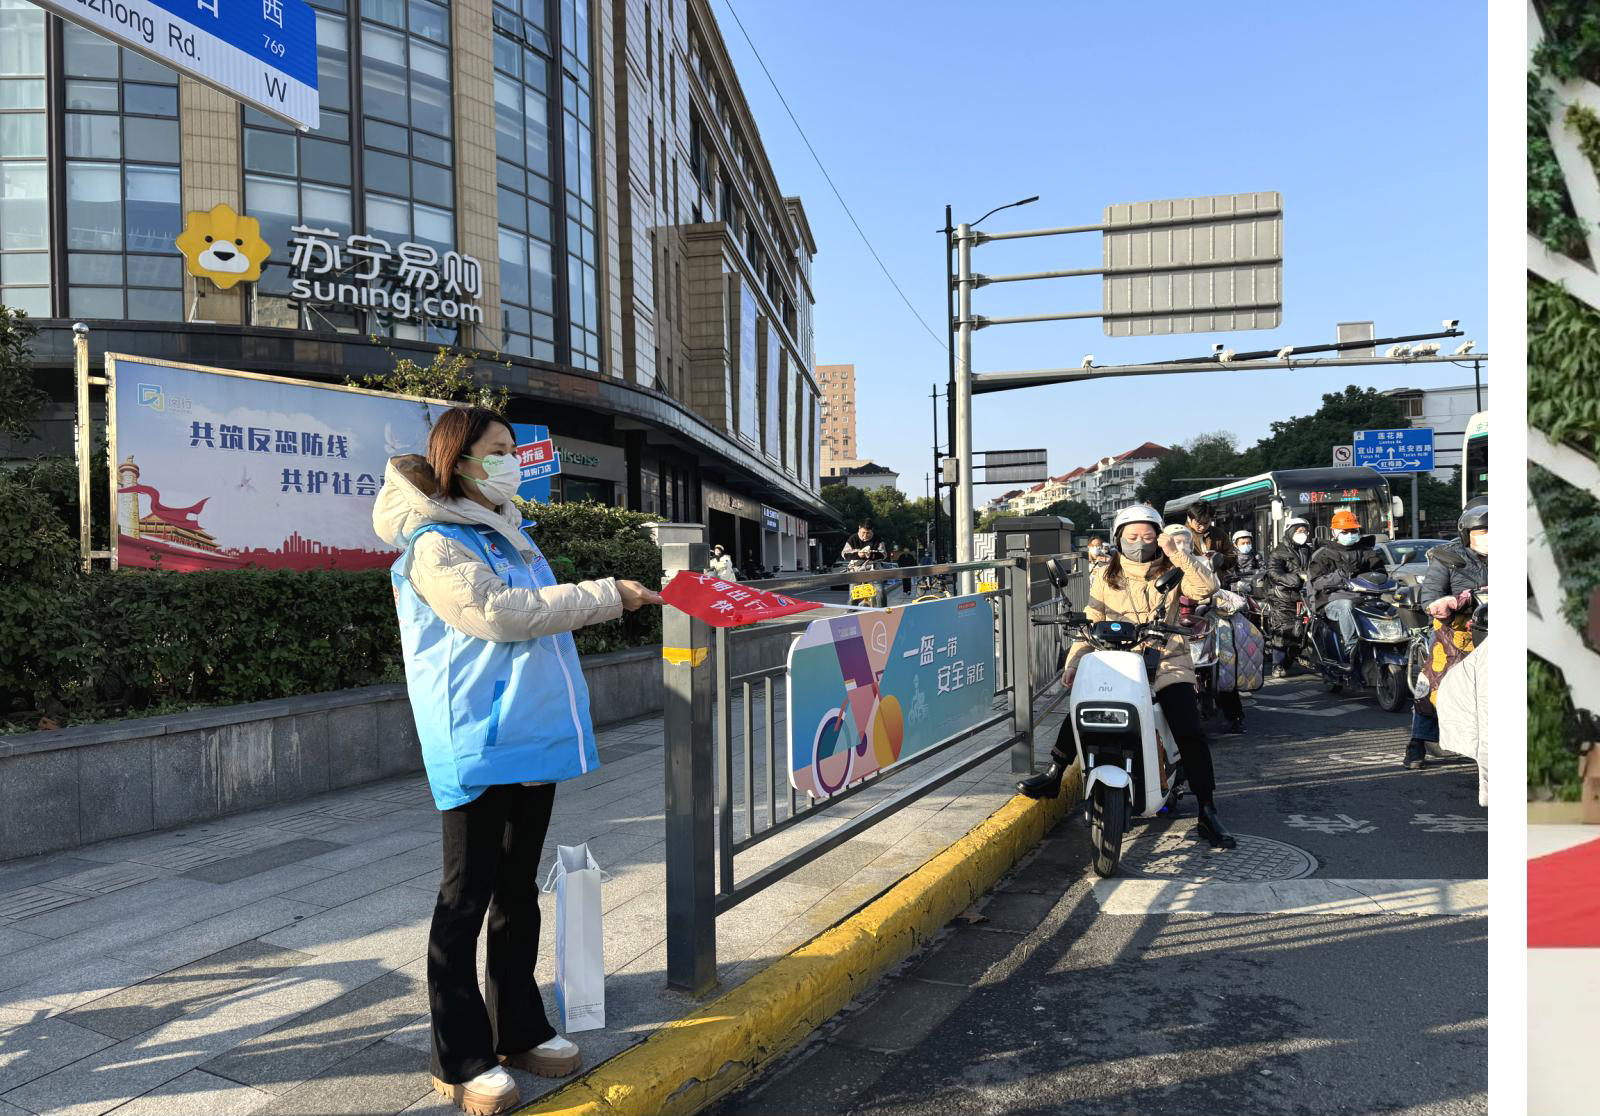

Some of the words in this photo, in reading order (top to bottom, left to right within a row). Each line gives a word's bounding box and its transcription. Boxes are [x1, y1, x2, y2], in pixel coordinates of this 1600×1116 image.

[168, 23, 201, 61] Rd.
[263, 34, 285, 58] 769
[264, 72, 287, 103] W
[291, 225, 483, 299] 苏宁易购
[292, 279, 484, 323] suning.com
[189, 420, 349, 460] 共筑反恐防线
[937, 660, 985, 696] 安全常在
